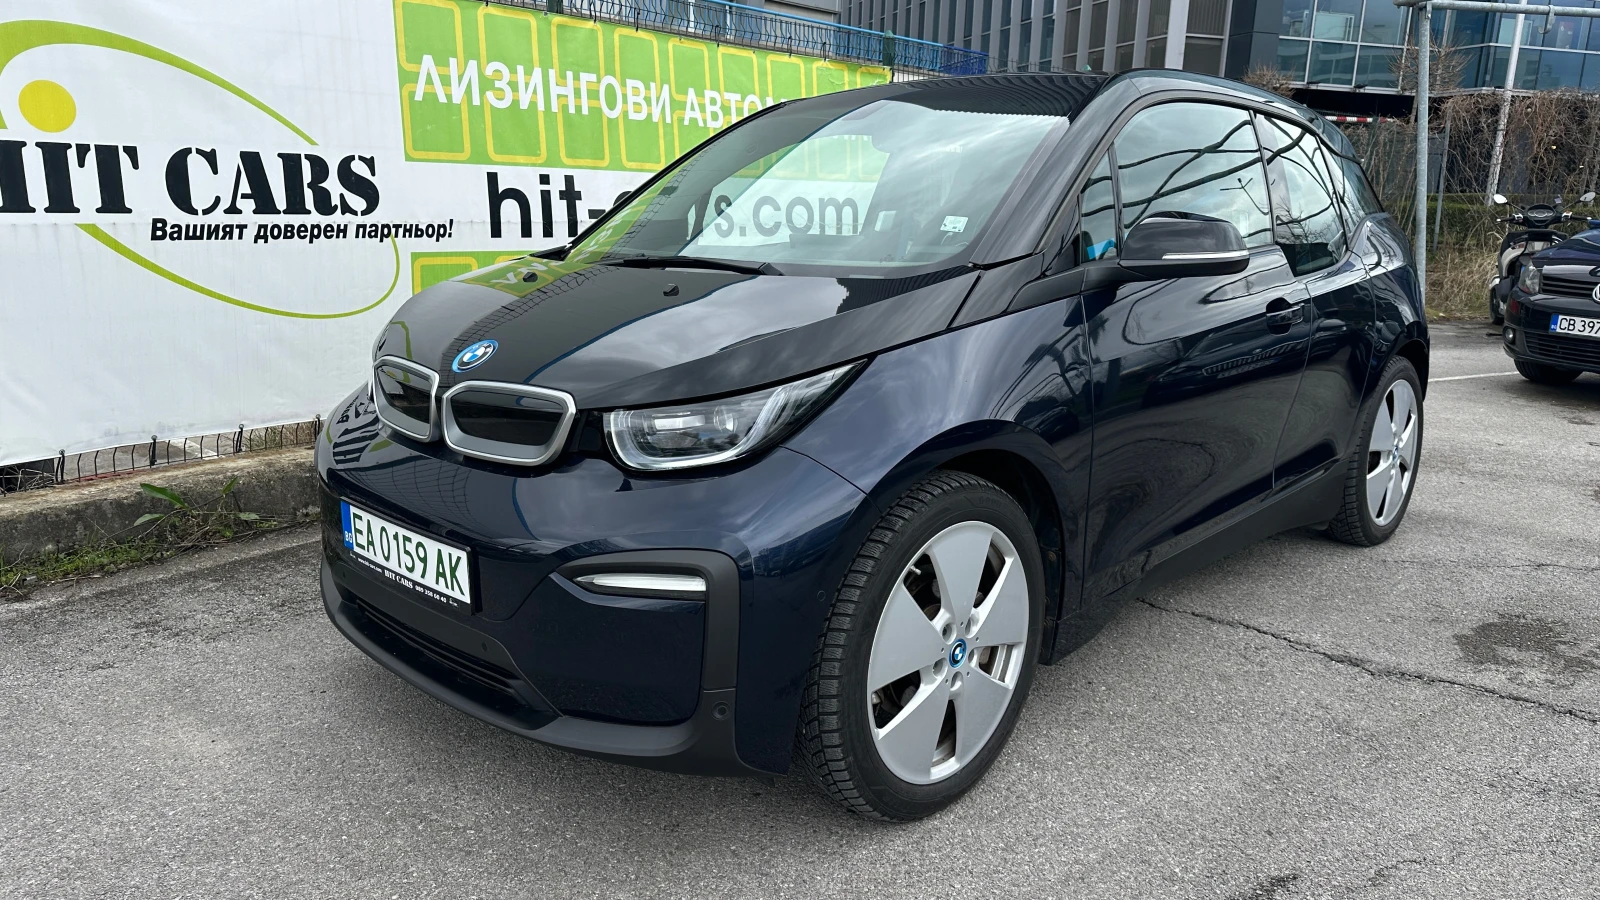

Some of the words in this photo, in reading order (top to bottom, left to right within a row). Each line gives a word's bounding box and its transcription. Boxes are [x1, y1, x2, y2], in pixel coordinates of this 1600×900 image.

[414, 54, 671, 124] ЛИЗИНГОВИ
[684, 87, 787, 129] АВТО
[165, 147, 379, 216] CARS
[150, 217, 247, 241] Вашият
[254, 222, 348, 244] доверен
[355, 218, 454, 240] партньор!
[1559, 317, 1576, 331] CB
[345, 530, 353, 543] BG
[352, 512, 377, 557] EA
[380, 525, 428, 579] 0159
[435, 548, 465, 596] AK
[396, 575, 414, 589] CARS
